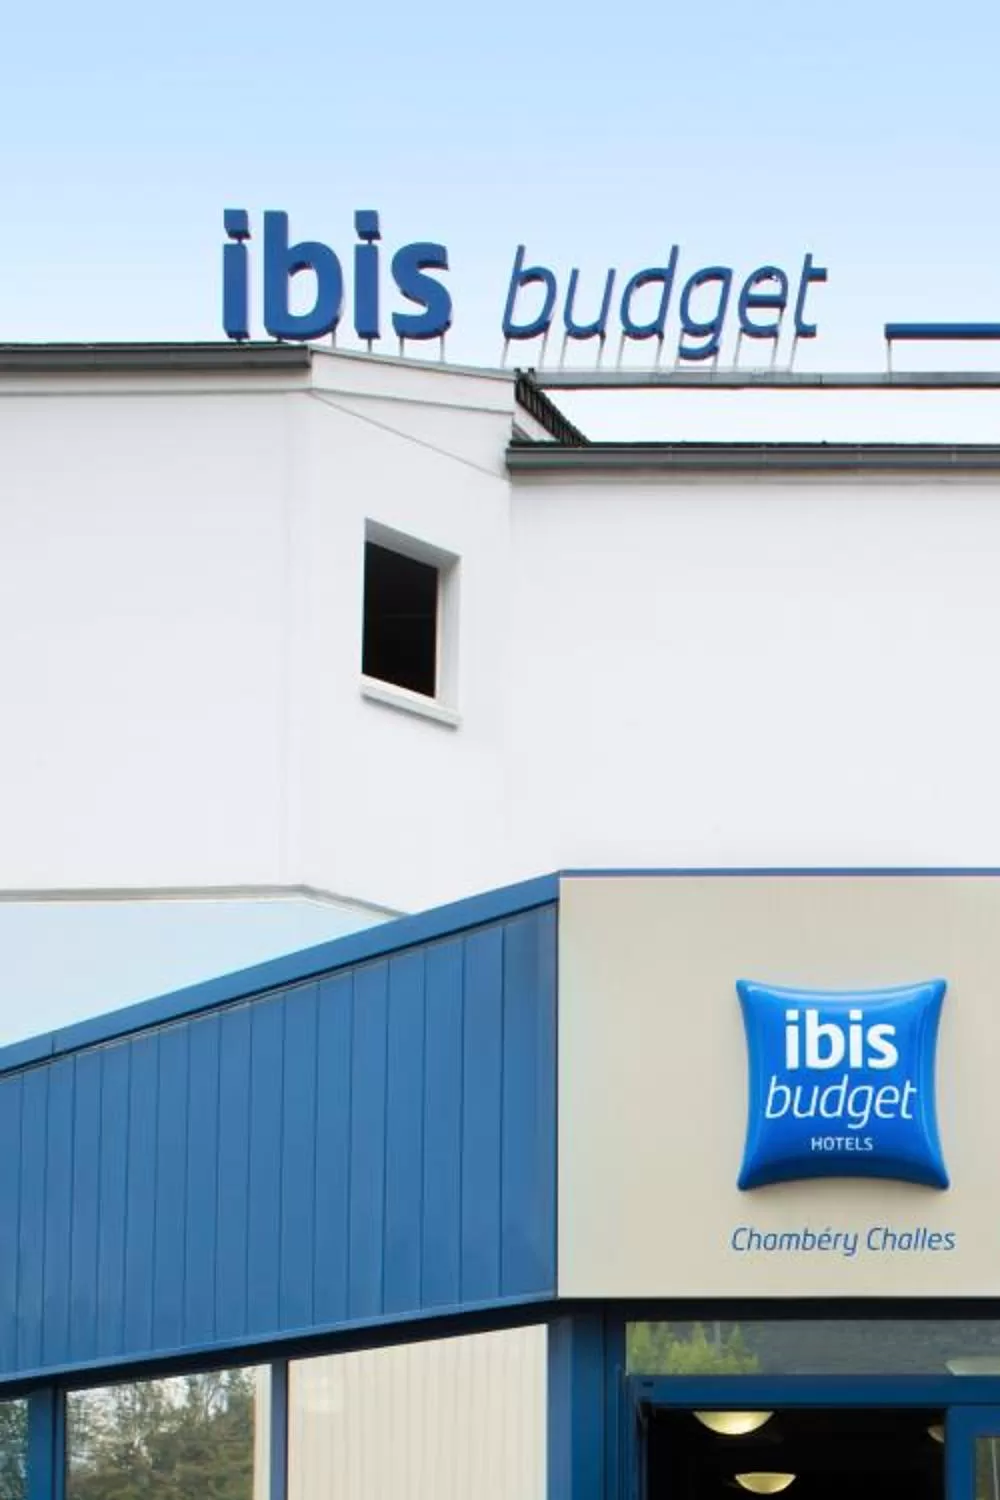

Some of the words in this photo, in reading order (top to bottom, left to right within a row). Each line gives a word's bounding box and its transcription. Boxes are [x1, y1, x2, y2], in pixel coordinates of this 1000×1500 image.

[223, 209, 453, 341] ibis
[501, 244, 828, 361] budget
[785, 1009, 899, 1070] ibis
[765, 1074, 917, 1130] budget
[811, 1136, 874, 1152] HOTELS
[731, 1227, 859, 1257] Chambéry
[866, 1227, 956, 1252] Challes
